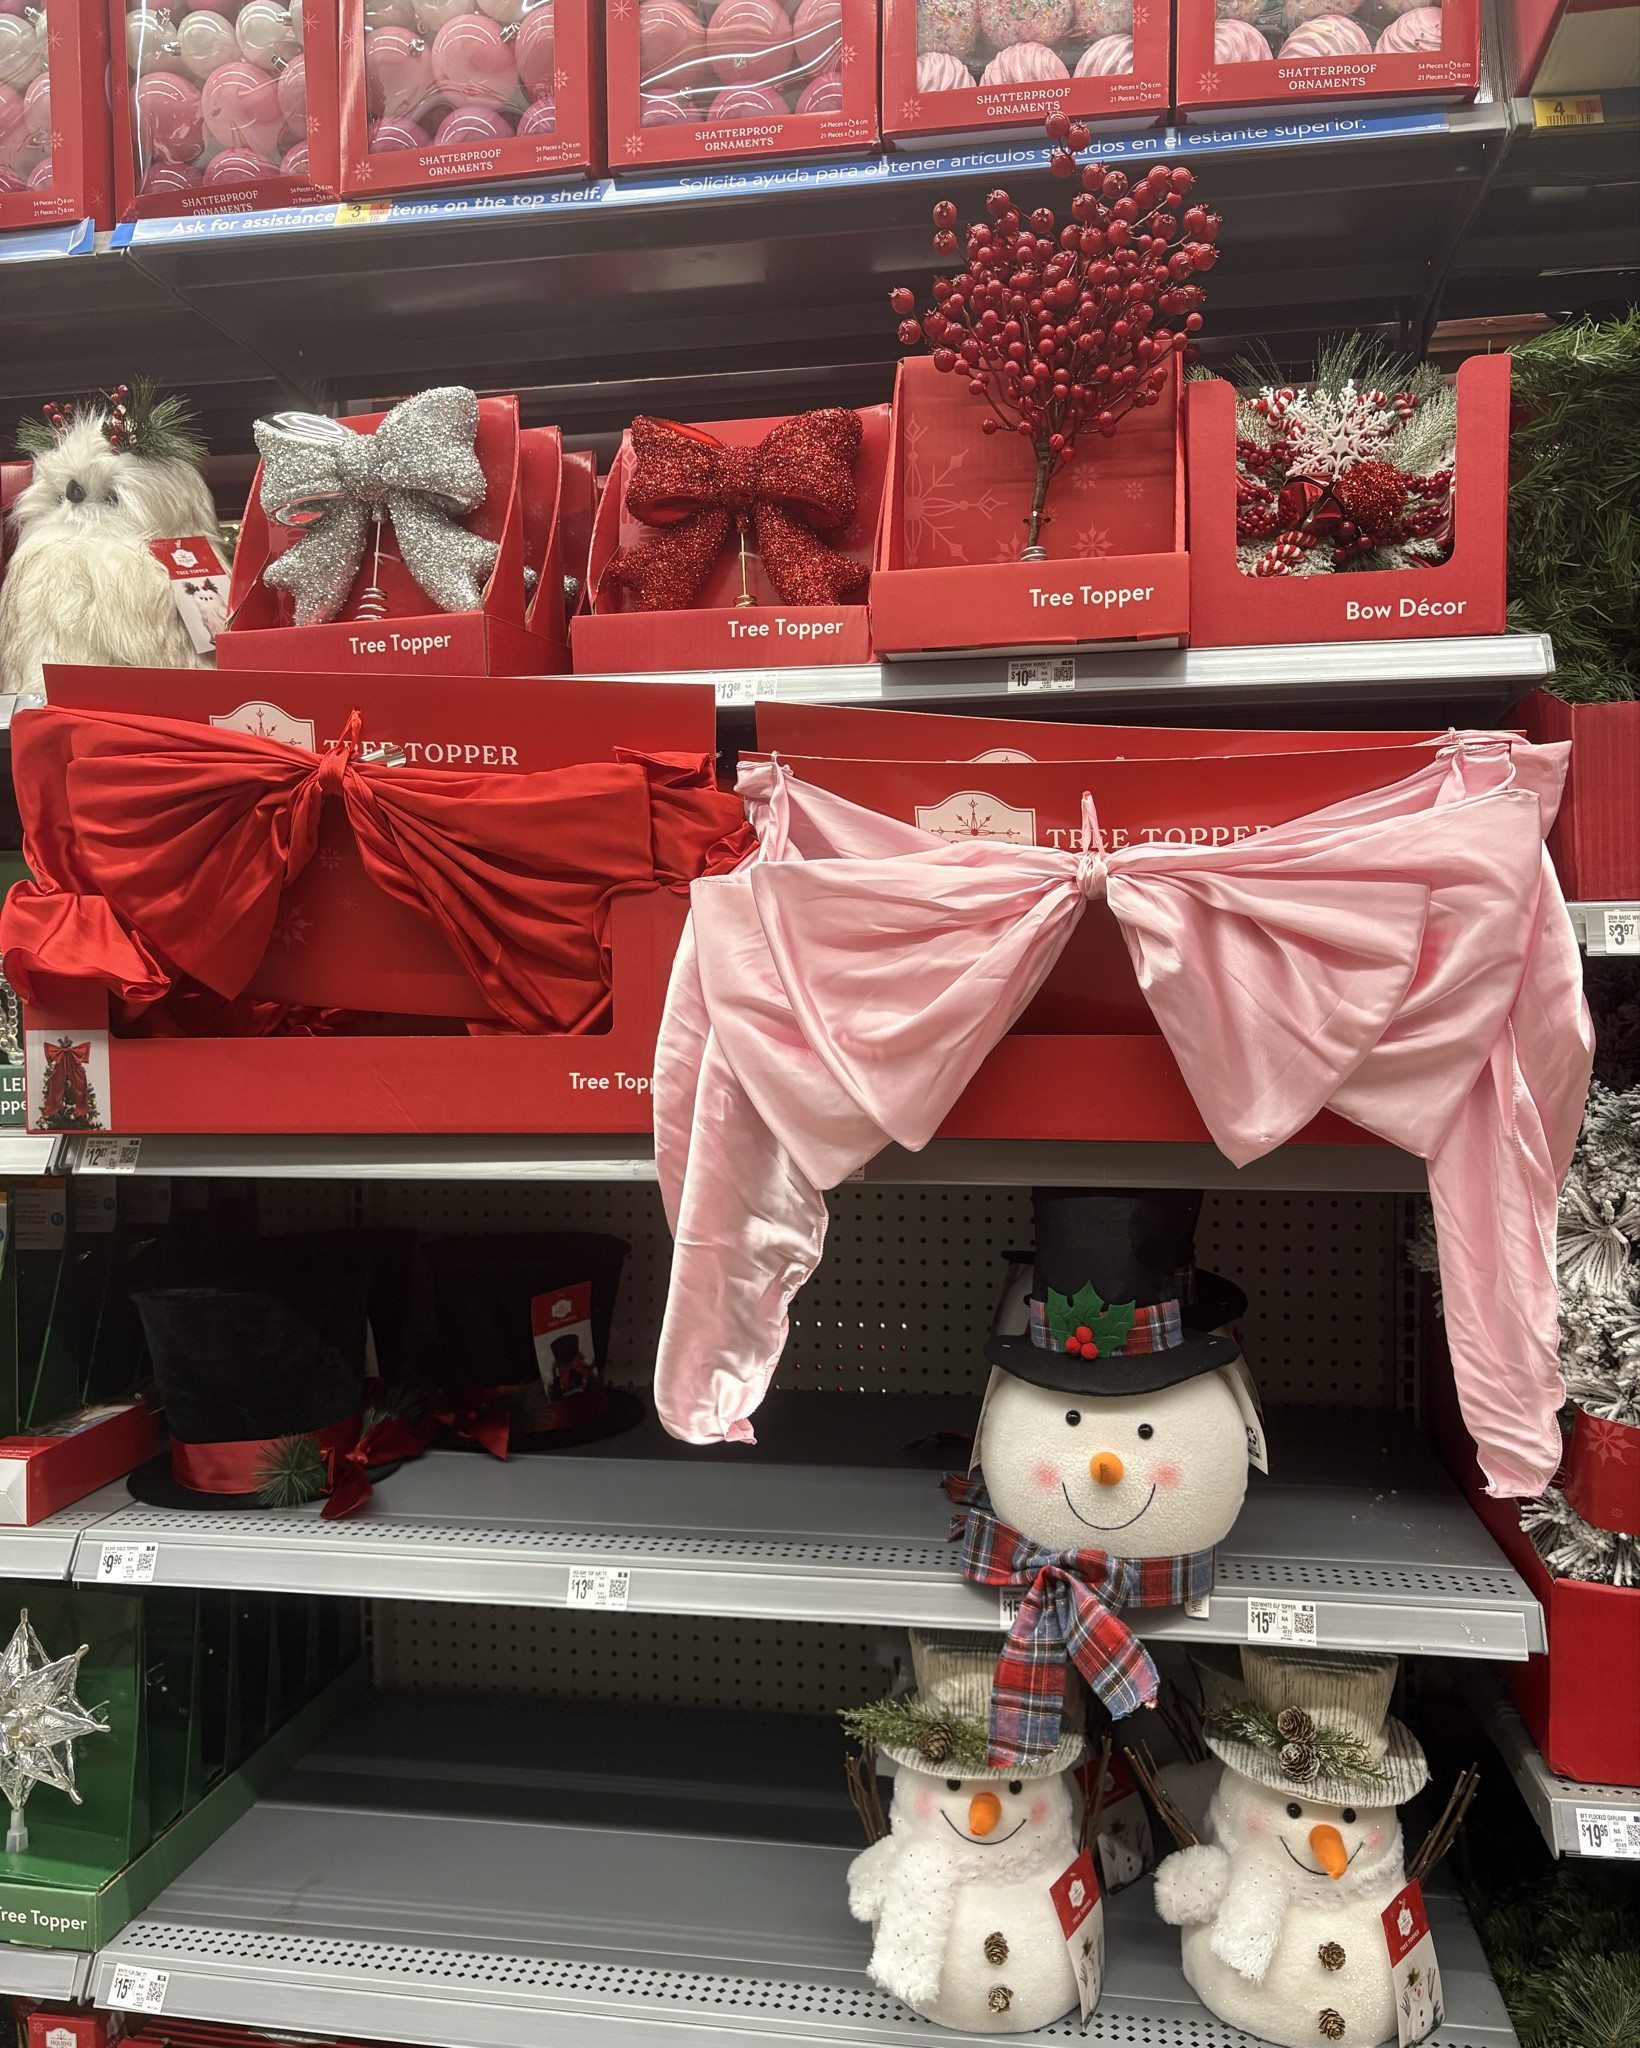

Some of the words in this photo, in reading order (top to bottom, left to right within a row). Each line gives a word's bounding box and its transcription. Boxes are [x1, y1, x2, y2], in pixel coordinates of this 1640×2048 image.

[1278, 63, 1378, 79] SHATTERPROOF
[1426, 62, 1444, 70] Pieces
[1288, 76, 1366, 90] ORNAMENTS
[1426, 73, 1444, 81] Pieces
[976, 87, 1071, 105] SHATTERPROOF
[987, 100, 1061, 116] ORNAMENTS
[1554, 101, 1565, 115] 4
[695, 124, 783, 142] SHATTERPROOF
[704, 137, 774, 151] ORNAMENTS
[419, 149, 502, 166] SHATTERPROOF
[679, 175, 746, 192] Solicita
[752, 168, 809, 190] ayuda
[815, 165, 858, 184] para
[864, 157, 944, 176] obtener
[950, 150, 1035, 168] artículos
[1132, 138, 1157, 149] en
[1164, 132, 1181, 147] el
[1189, 126, 1268, 145] estante
[1274, 116, 1367, 140] superior.
[428, 161, 493, 177] ORNAMENTS
[182, 190, 259, 208] SHATTERPROOF
[169, 220, 206, 235] Ask
[210, 218, 237, 232] for
[242, 211, 337, 230] assistance
[388, 203, 437, 217] items
[444, 200, 468, 213] on
[474, 196, 506, 210] the
[512, 194, 543, 210] top
[550, 186, 602, 204] shelf.
[193, 203, 253, 217] ORNAMENTS
[351, 205, 362, 218] 3
[1029, 588, 1074, 608] Tree
[1079, 585, 1155, 609] Topper
[1346, 601, 1392, 620] Bow
[1399, 597, 1467, 618] Décor
[727, 620, 770, 638] Tree
[775, 618, 844, 640] Topper
[348, 637, 386, 655] Tree
[390, 633, 451, 655] Topper
[404, 742, 519, 766] TOPPER
[568, 1072, 610, 1089] Tree
[0, 1906, 27, 1924] ree
[30, 1909, 88, 1933] Topper
[50, 2039, 73, 2047] HOLIDAY
